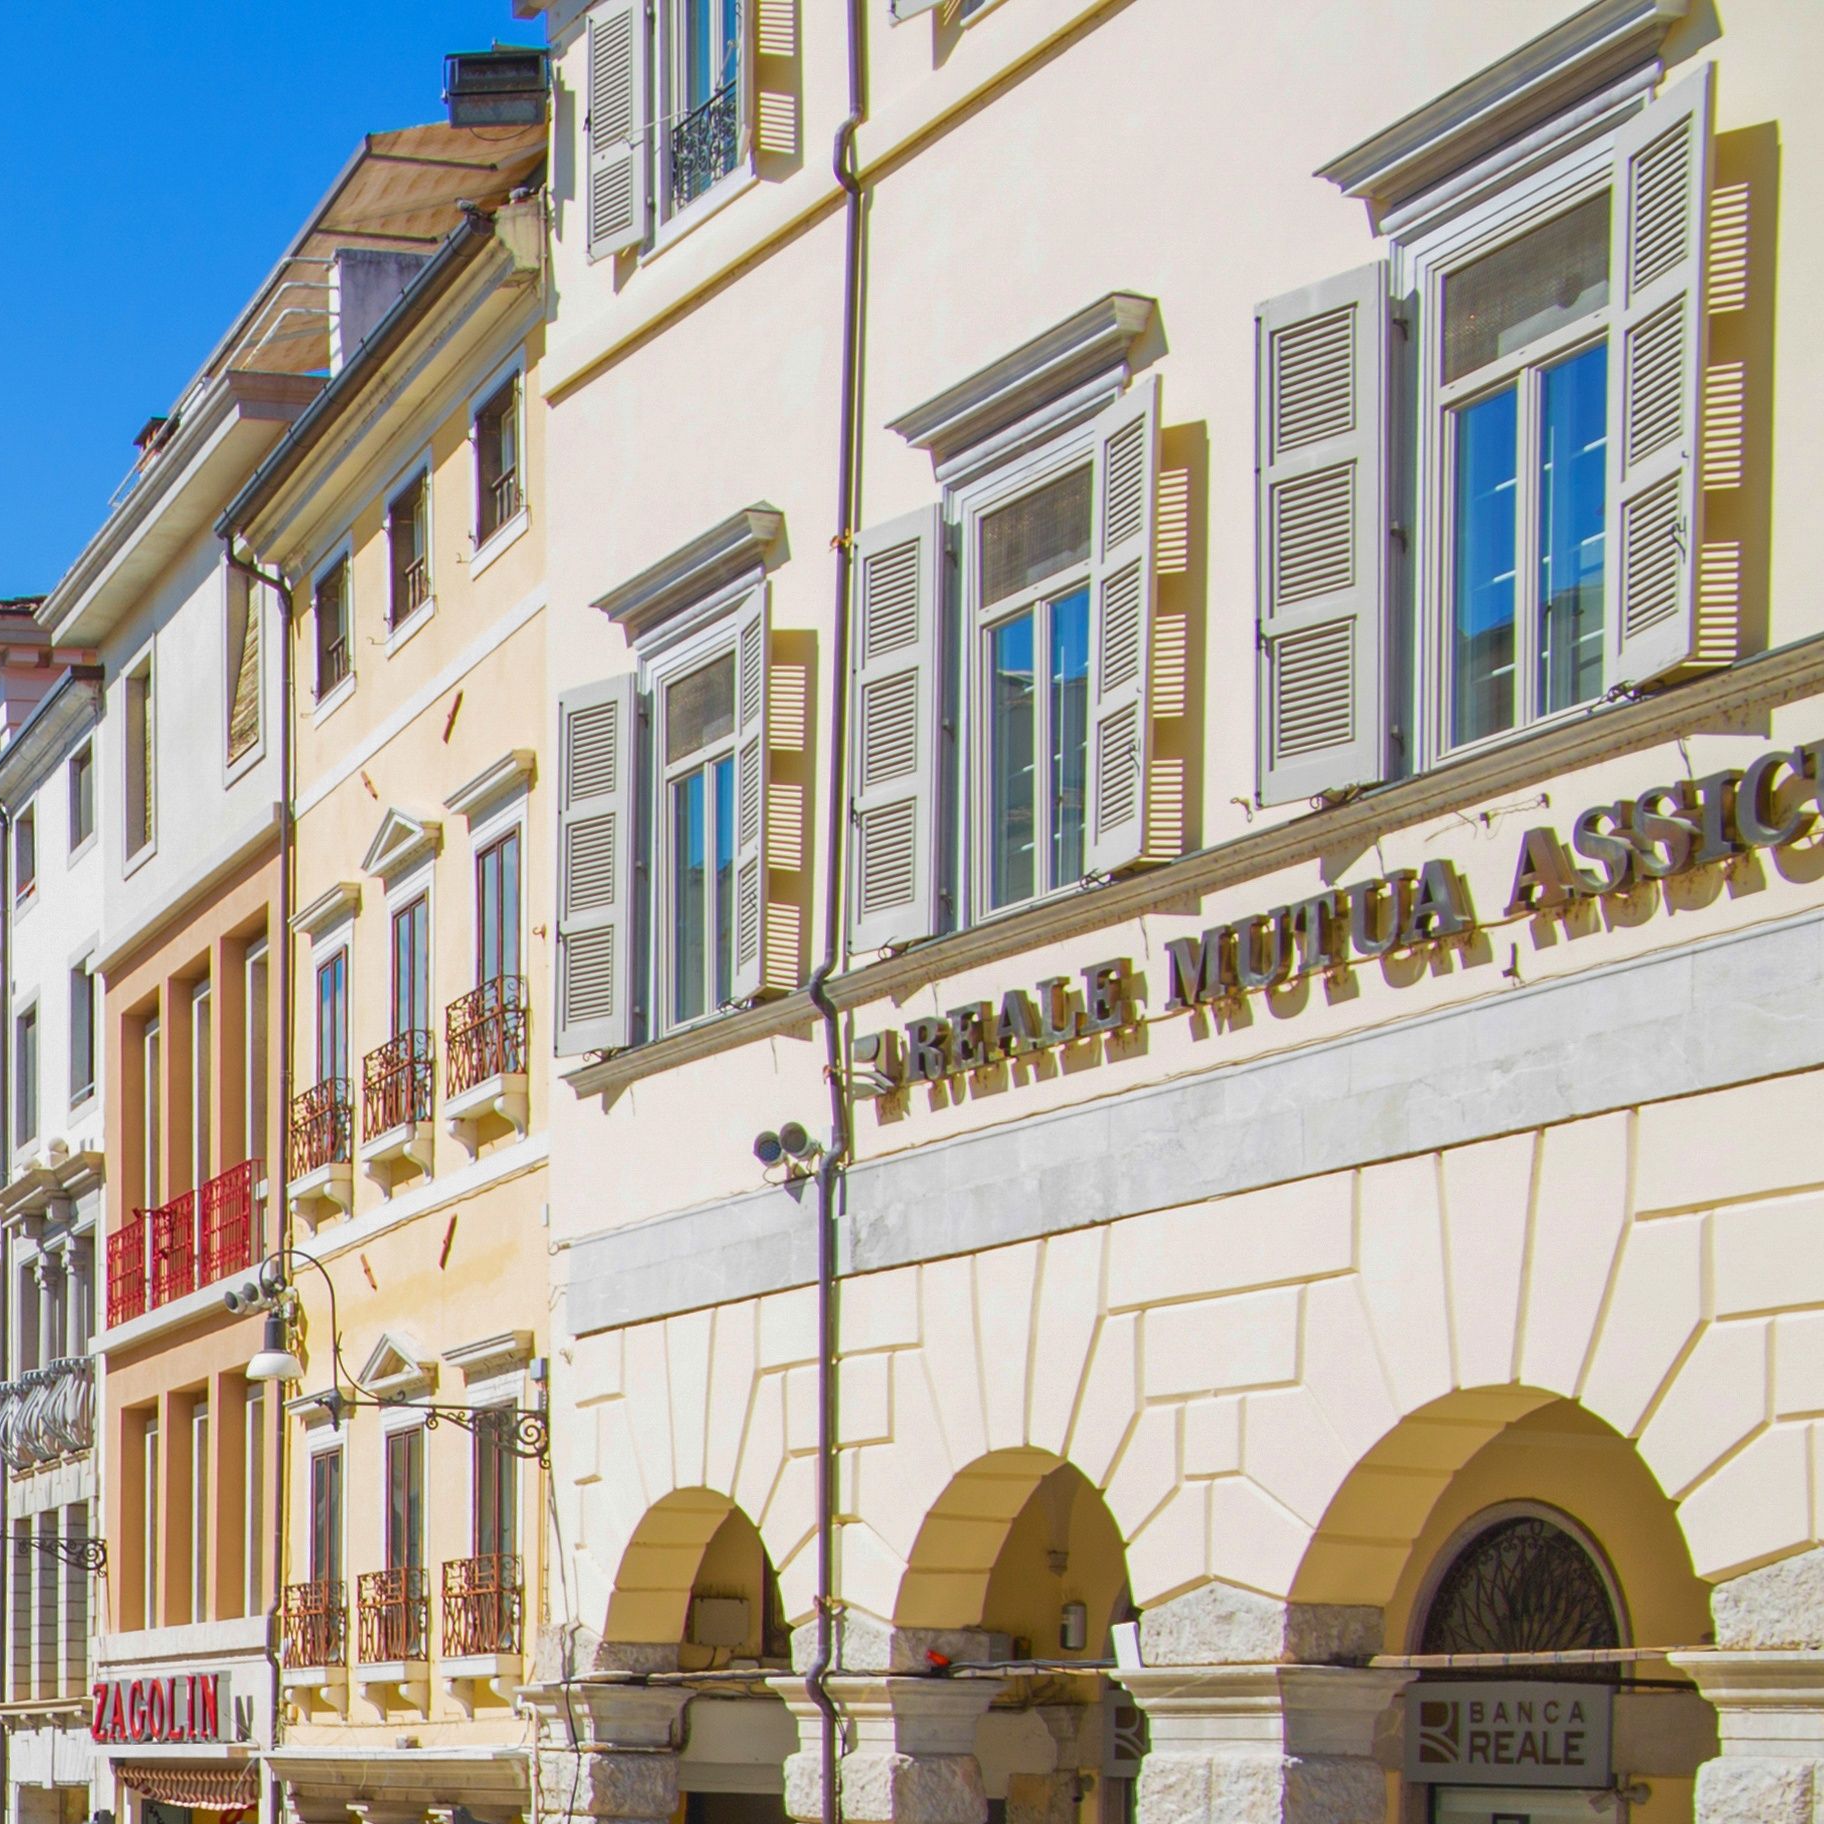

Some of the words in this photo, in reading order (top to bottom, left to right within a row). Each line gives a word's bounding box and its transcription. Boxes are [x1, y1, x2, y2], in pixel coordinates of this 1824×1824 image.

[904, 957, 1133, 1081] REALE
[1164, 859, 1470, 1012] MUTUA
[92, 1674, 219, 1742] ZAGOLIN
[1469, 1701, 1585, 1724] BANCA
[1469, 1730, 1585, 1766] REALE
